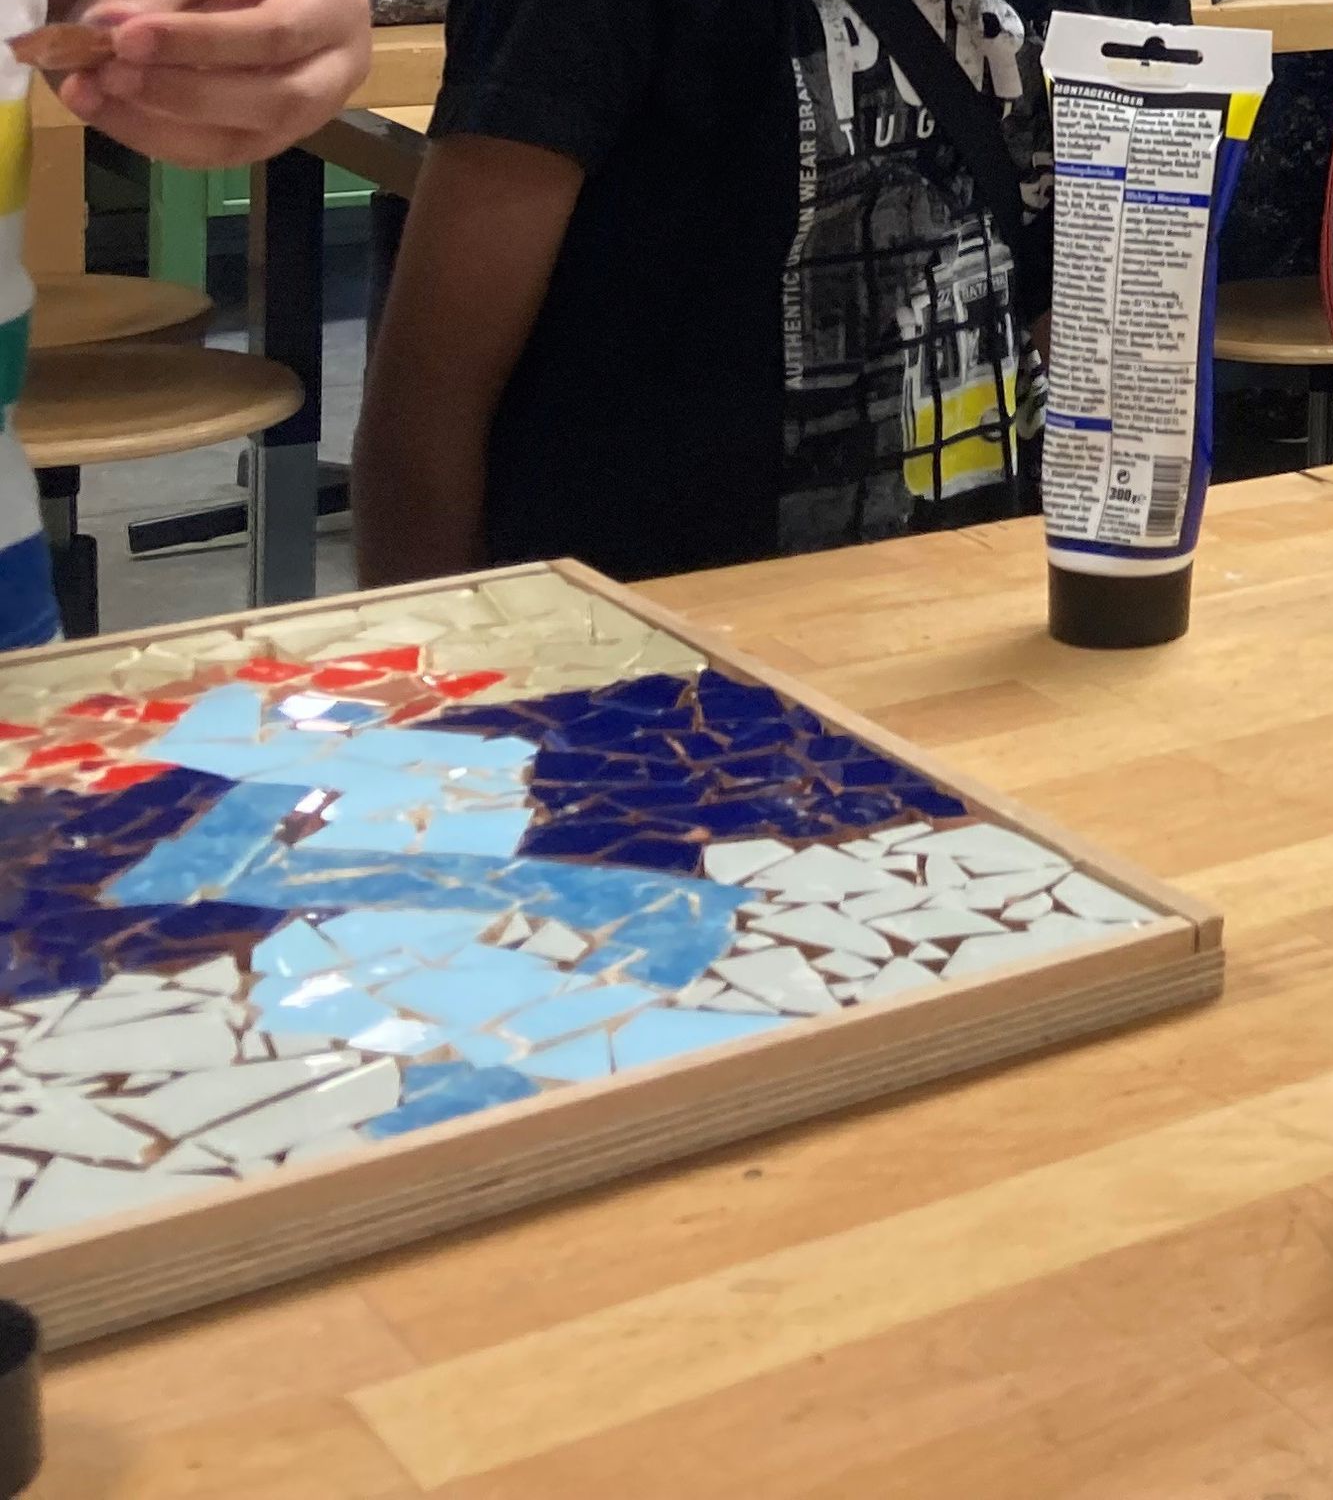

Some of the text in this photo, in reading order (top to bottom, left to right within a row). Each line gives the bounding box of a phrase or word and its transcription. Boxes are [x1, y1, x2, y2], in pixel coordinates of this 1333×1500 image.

[1054, 84, 1144, 106] MONTAGEKLEBER
[782, 271, 803, 390] AUTHENTIC
[800, 140, 818, 202] WEAR
